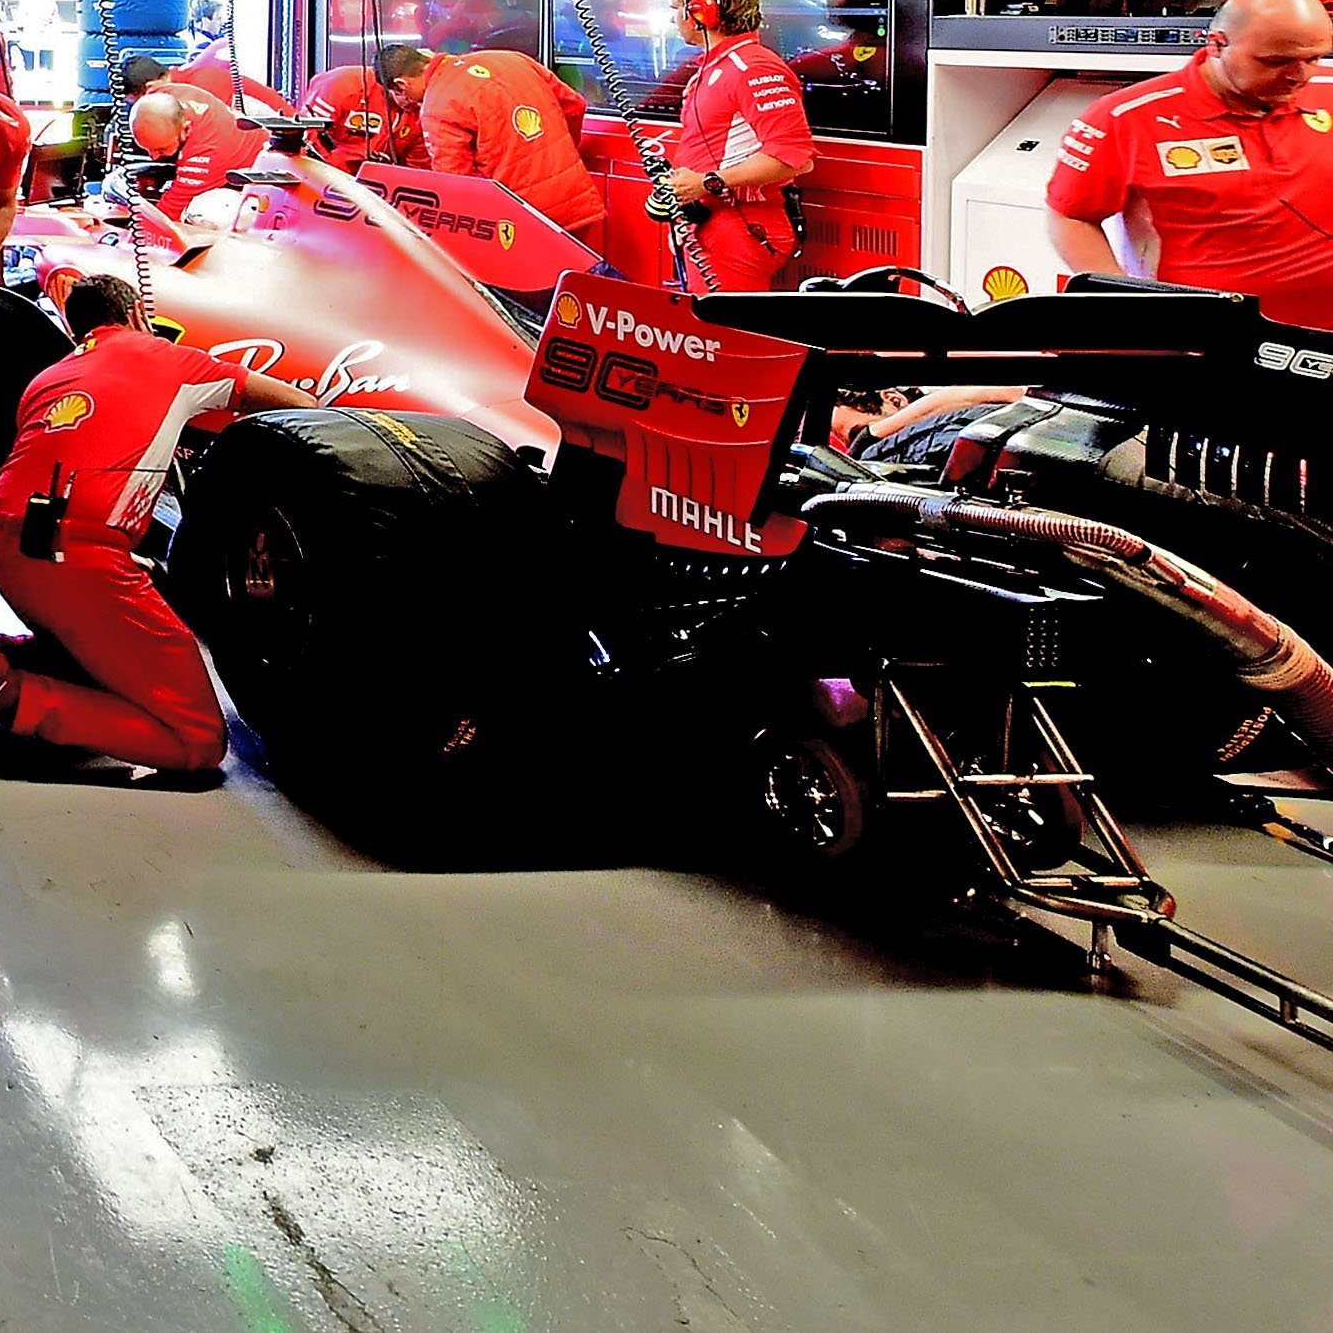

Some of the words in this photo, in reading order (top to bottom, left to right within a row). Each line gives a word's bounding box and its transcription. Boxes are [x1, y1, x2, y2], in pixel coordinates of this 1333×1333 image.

[403, 205, 497, 241] YEARS
[586, 303, 721, 363] V-Power
[617, 370, 729, 418] YEARS
[649, 485, 763, 556] MAHLE
